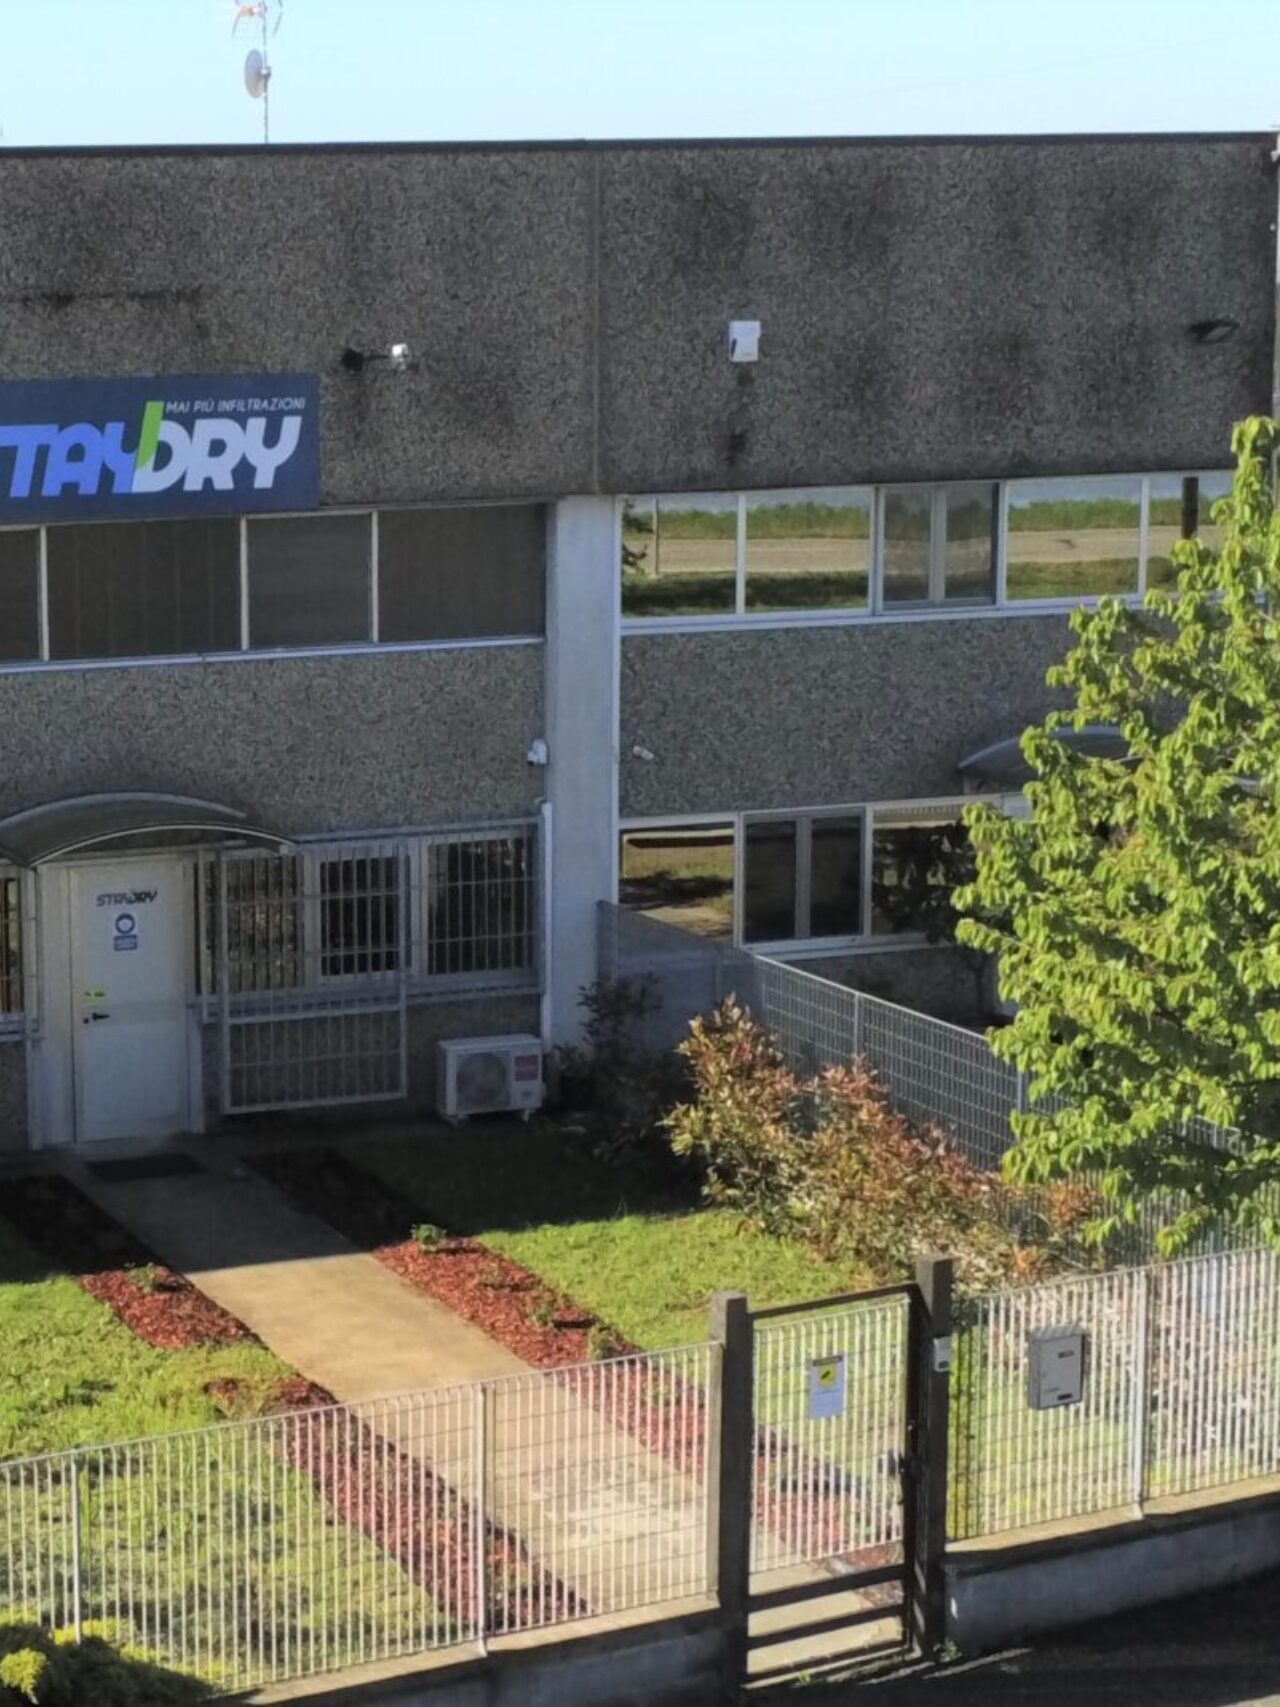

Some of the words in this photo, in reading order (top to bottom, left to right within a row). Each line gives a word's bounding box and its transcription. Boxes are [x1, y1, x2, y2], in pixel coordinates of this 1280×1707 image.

[166, 401, 190, 413] MAI
[194, 399, 214, 413] PIÙ
[218, 397, 305, 412] INFILTRAZIONI
